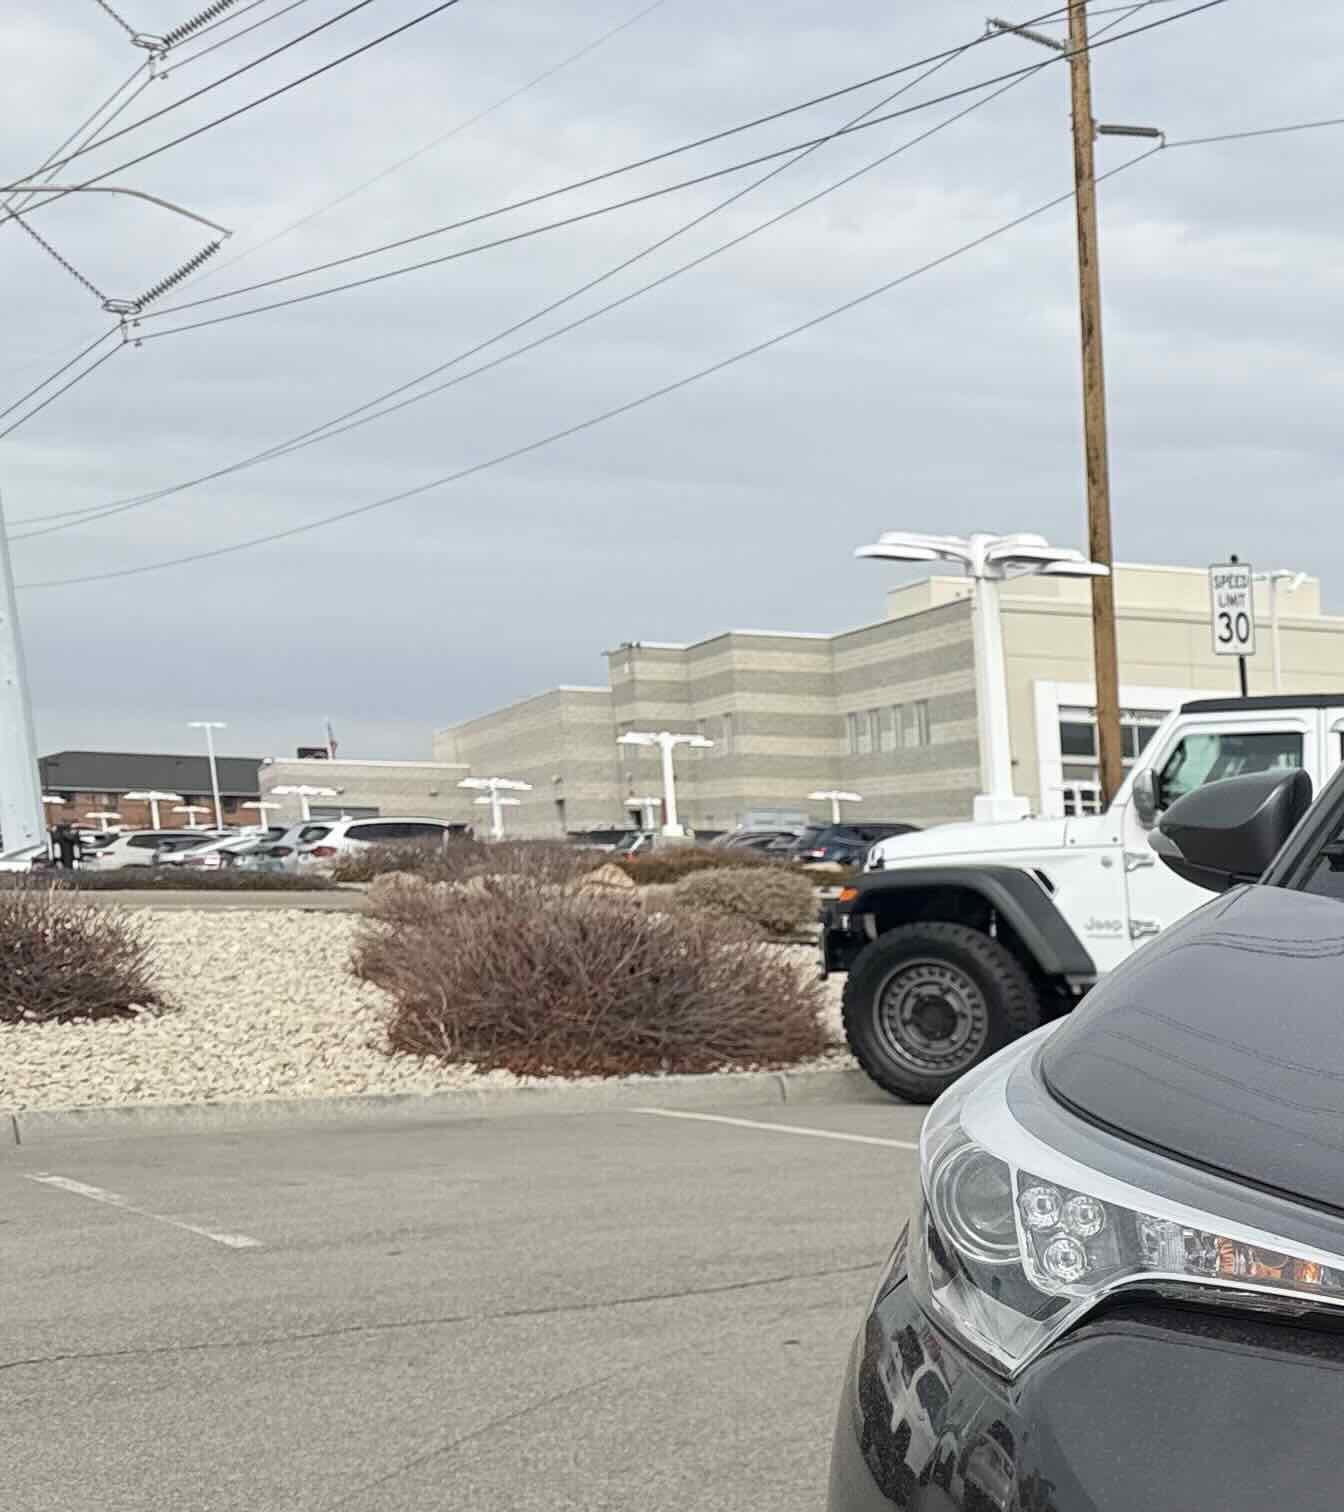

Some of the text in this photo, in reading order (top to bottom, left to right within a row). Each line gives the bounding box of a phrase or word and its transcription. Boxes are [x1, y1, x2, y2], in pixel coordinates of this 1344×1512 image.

[1214, 575, 1248, 589] SPEED
[1217, 593, 1246, 608] LIMIT
[1218, 612, 1249, 643] 30
[1084, 916, 1122, 931] Jeep
